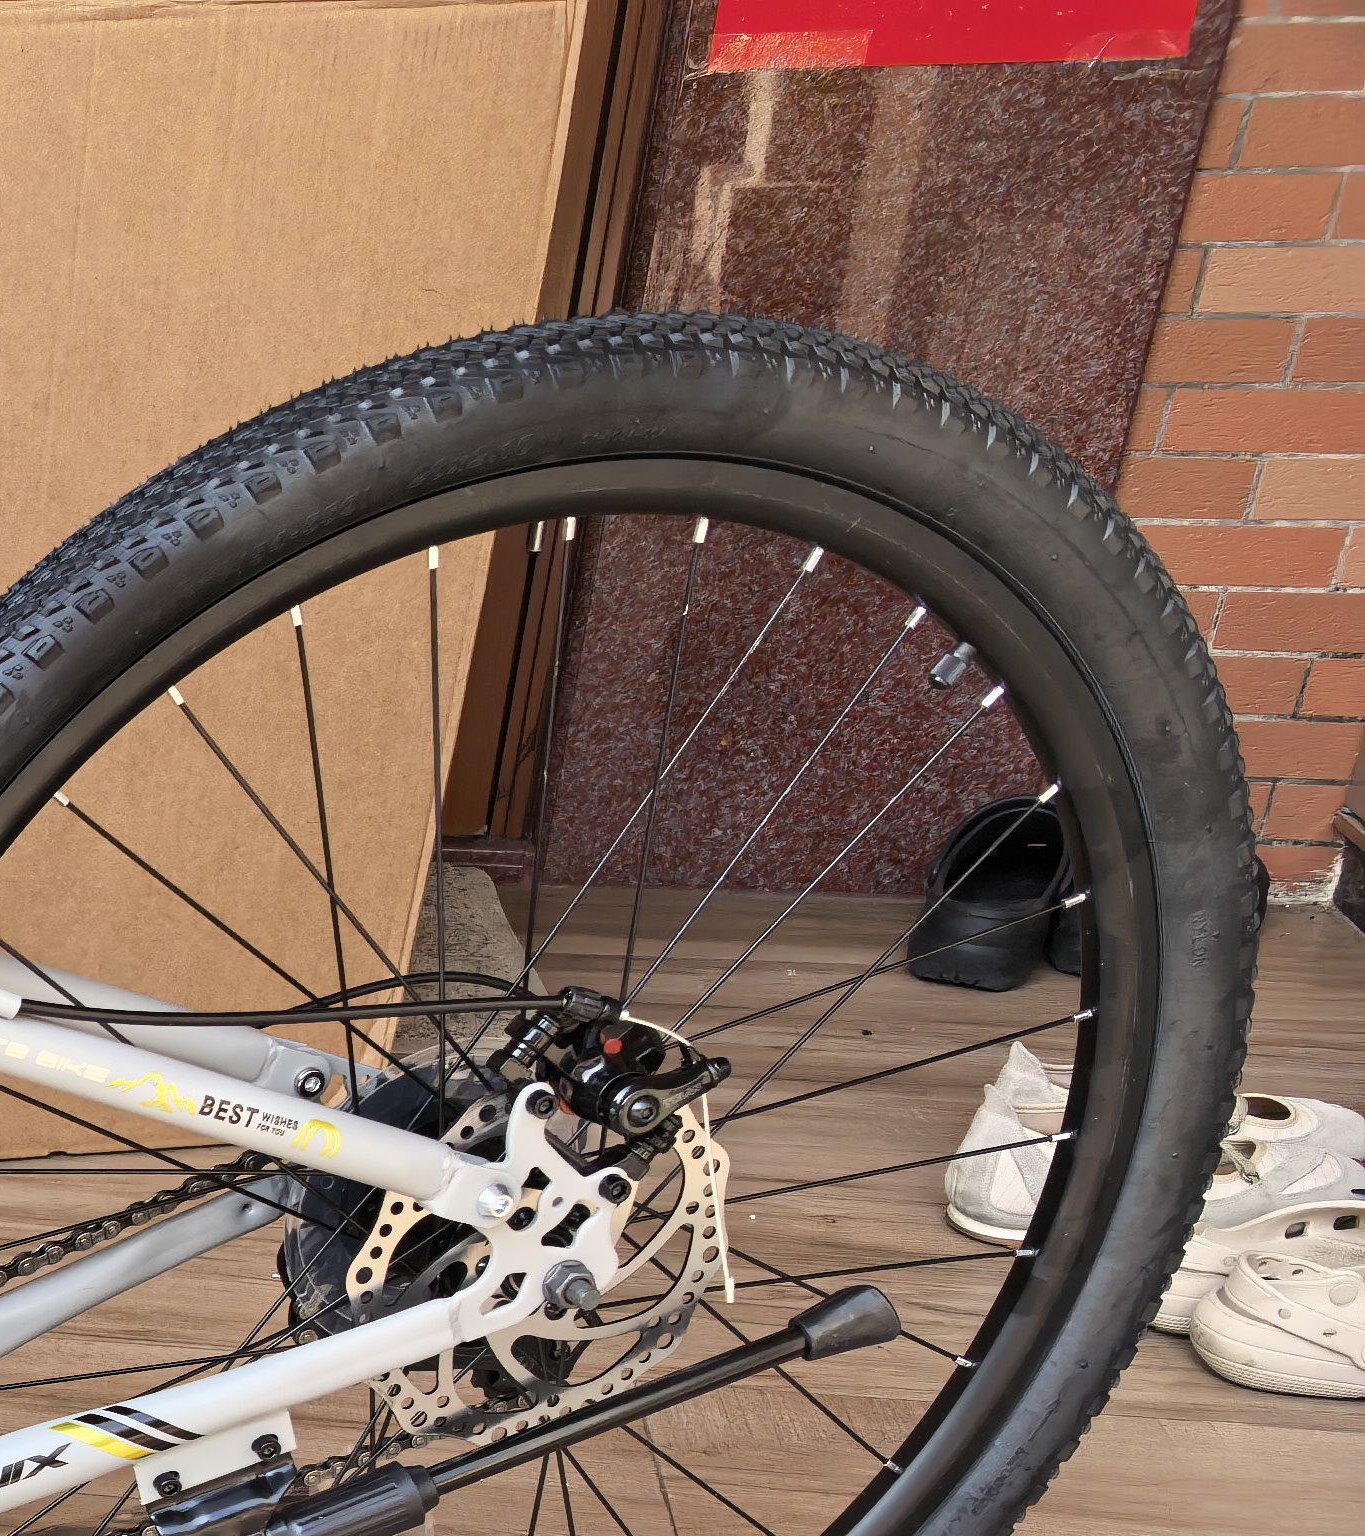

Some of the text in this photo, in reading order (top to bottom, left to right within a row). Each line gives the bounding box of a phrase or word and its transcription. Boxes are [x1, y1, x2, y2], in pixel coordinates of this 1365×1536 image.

[198, 1094, 299, 1131] BEST WISHES
[255, 1122, 270, 1133] FOR
